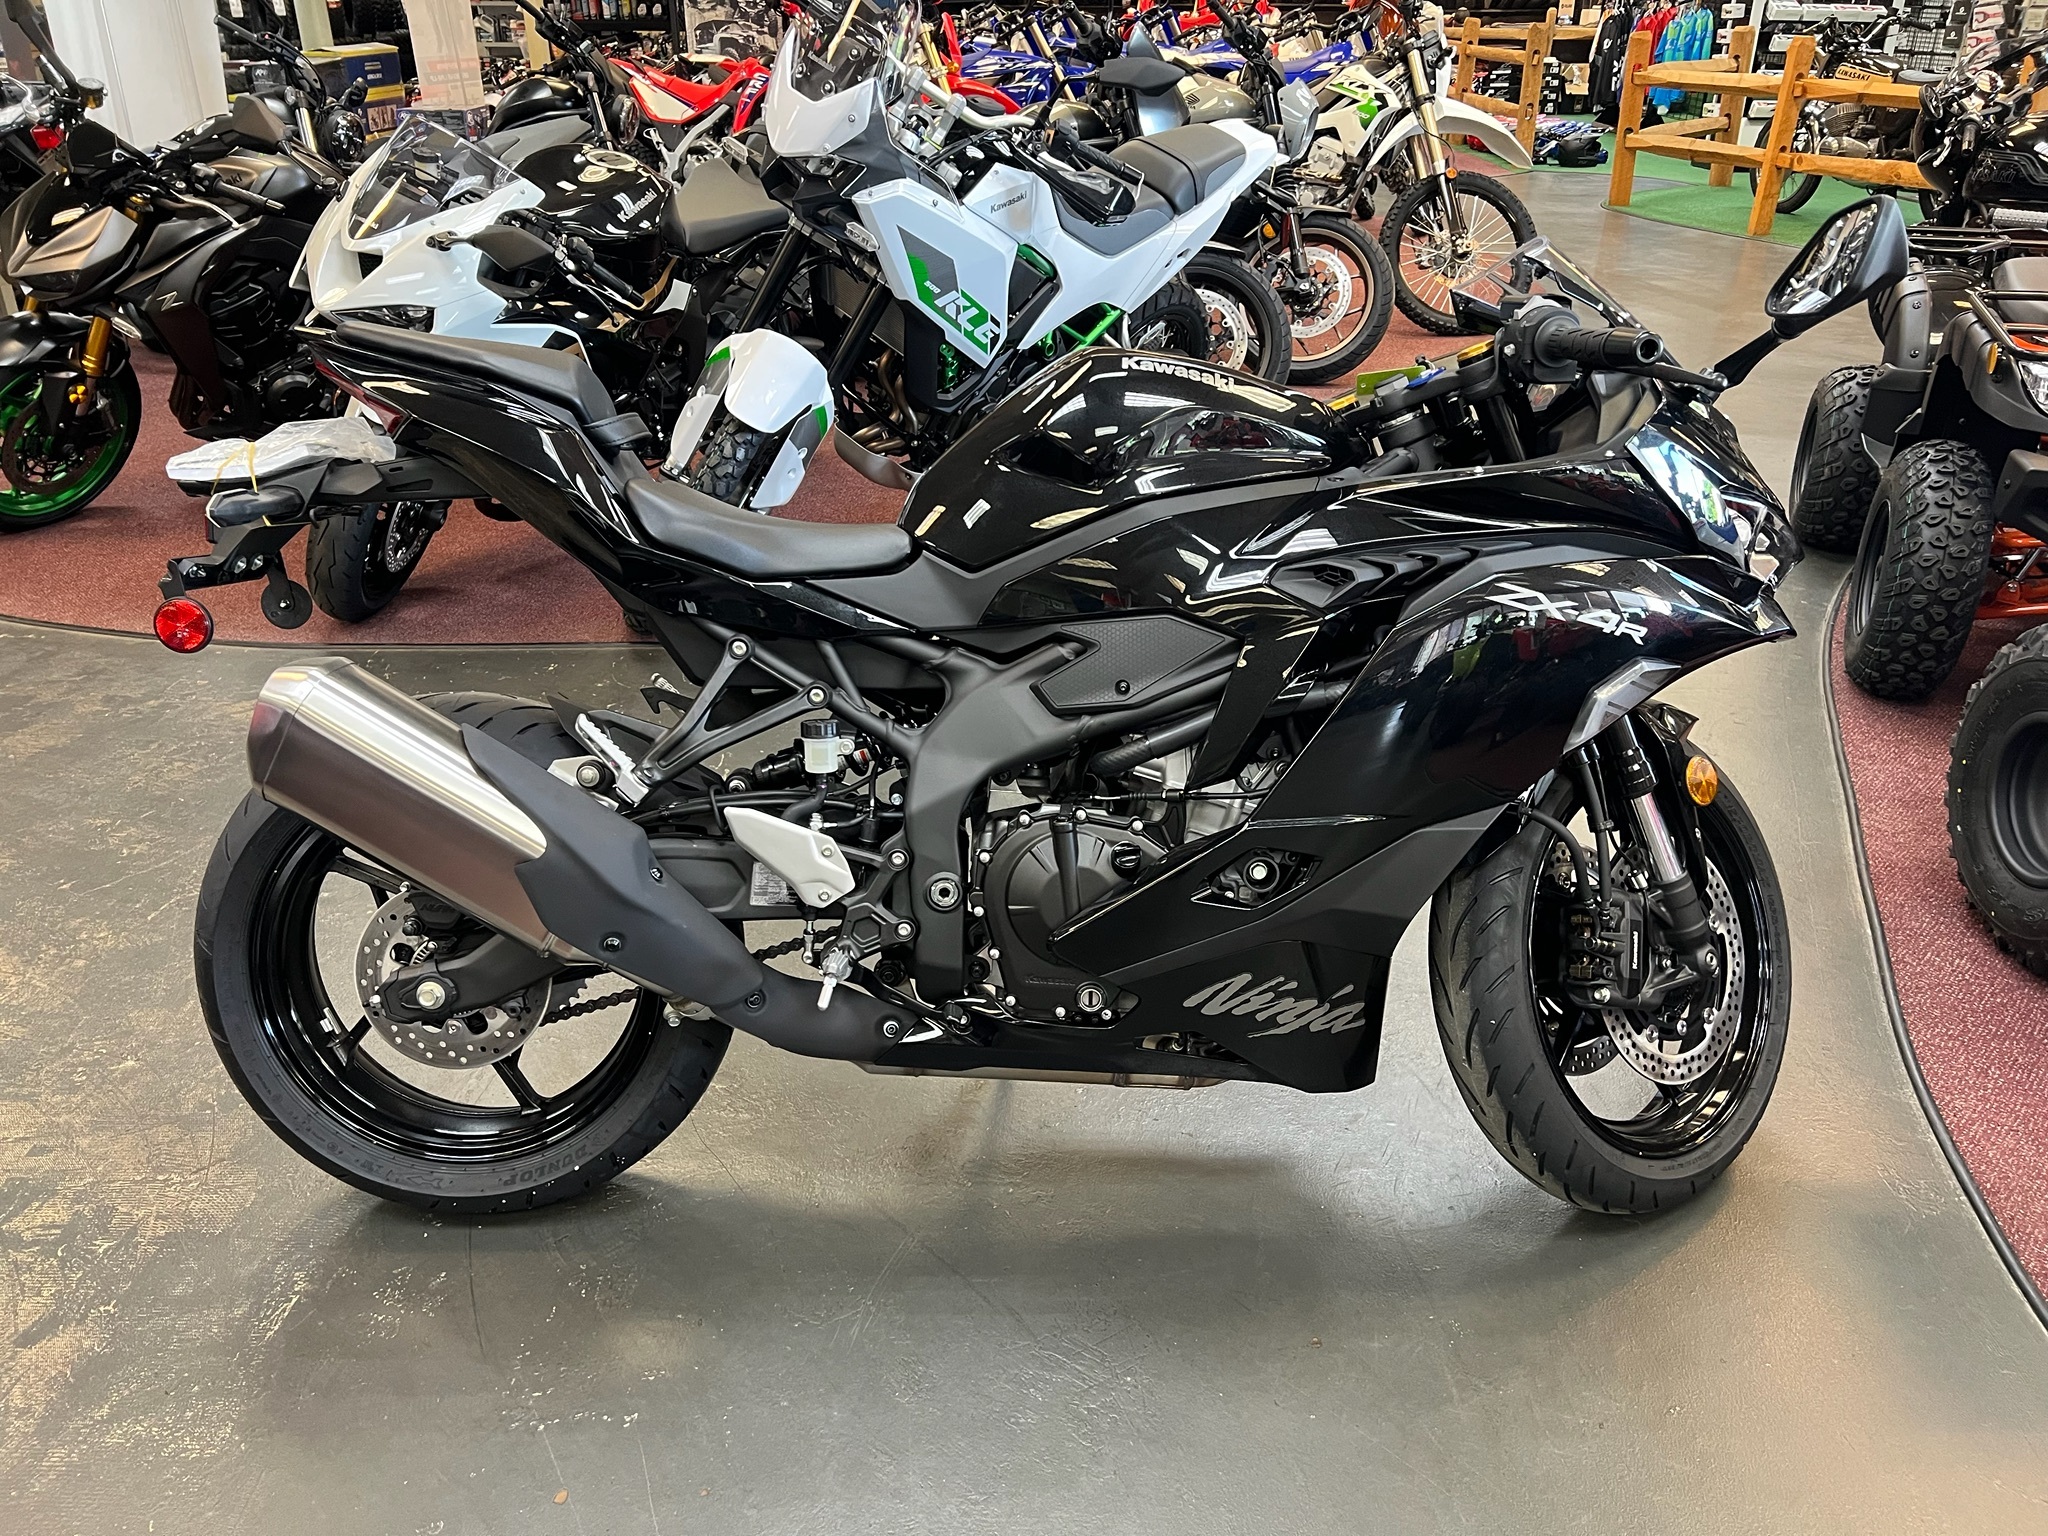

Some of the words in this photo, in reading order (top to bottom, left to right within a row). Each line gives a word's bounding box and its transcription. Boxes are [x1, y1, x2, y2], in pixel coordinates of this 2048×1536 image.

[617, 187, 658, 223] Kawasaki
[990, 191, 1028, 214] Kawasaki
[924, 280, 941, 294] 500
[1122, 356, 1235, 393] Kawasaki
[1183, 973, 1366, 1038] Ninja
[502, 1144, 590, 1187] DUNLOP
